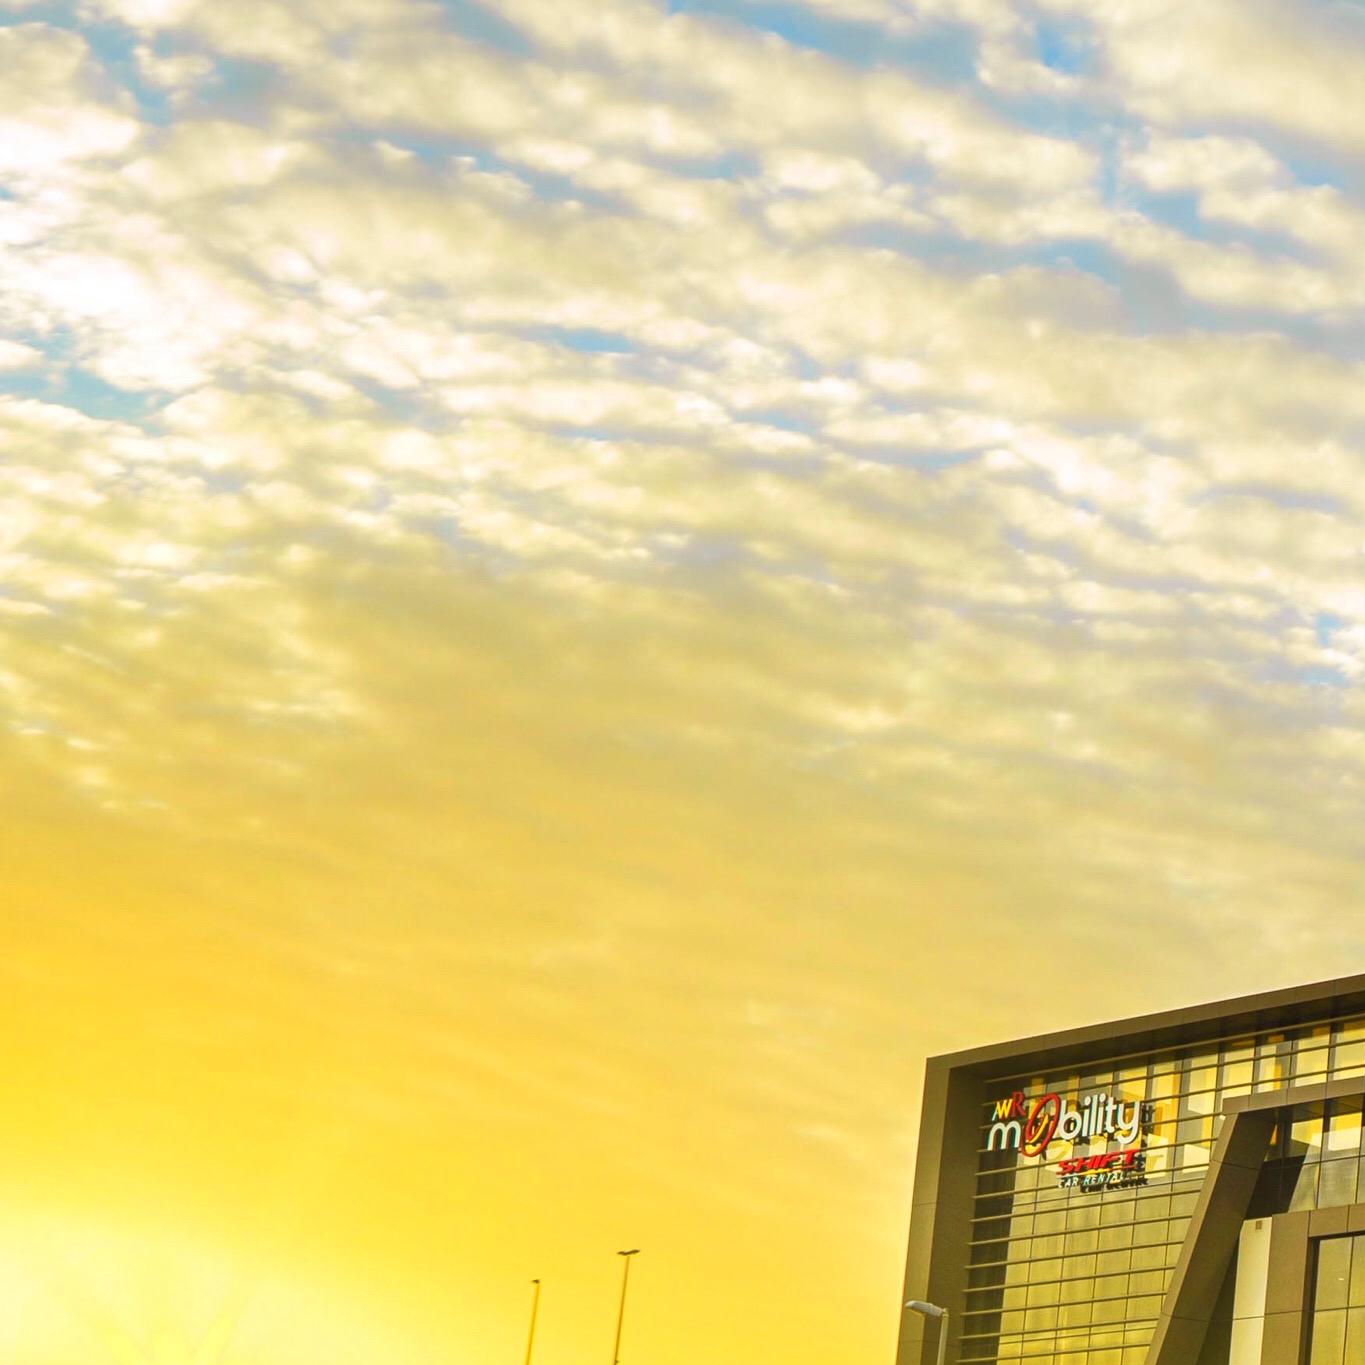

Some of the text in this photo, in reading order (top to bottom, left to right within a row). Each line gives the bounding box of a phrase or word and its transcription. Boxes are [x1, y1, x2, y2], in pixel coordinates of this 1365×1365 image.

[991, 1091, 1026, 1122] AWR
[1056, 1148, 1141, 1175] SHIFT
[1057, 1170, 1125, 1189] CAR RENTAL
